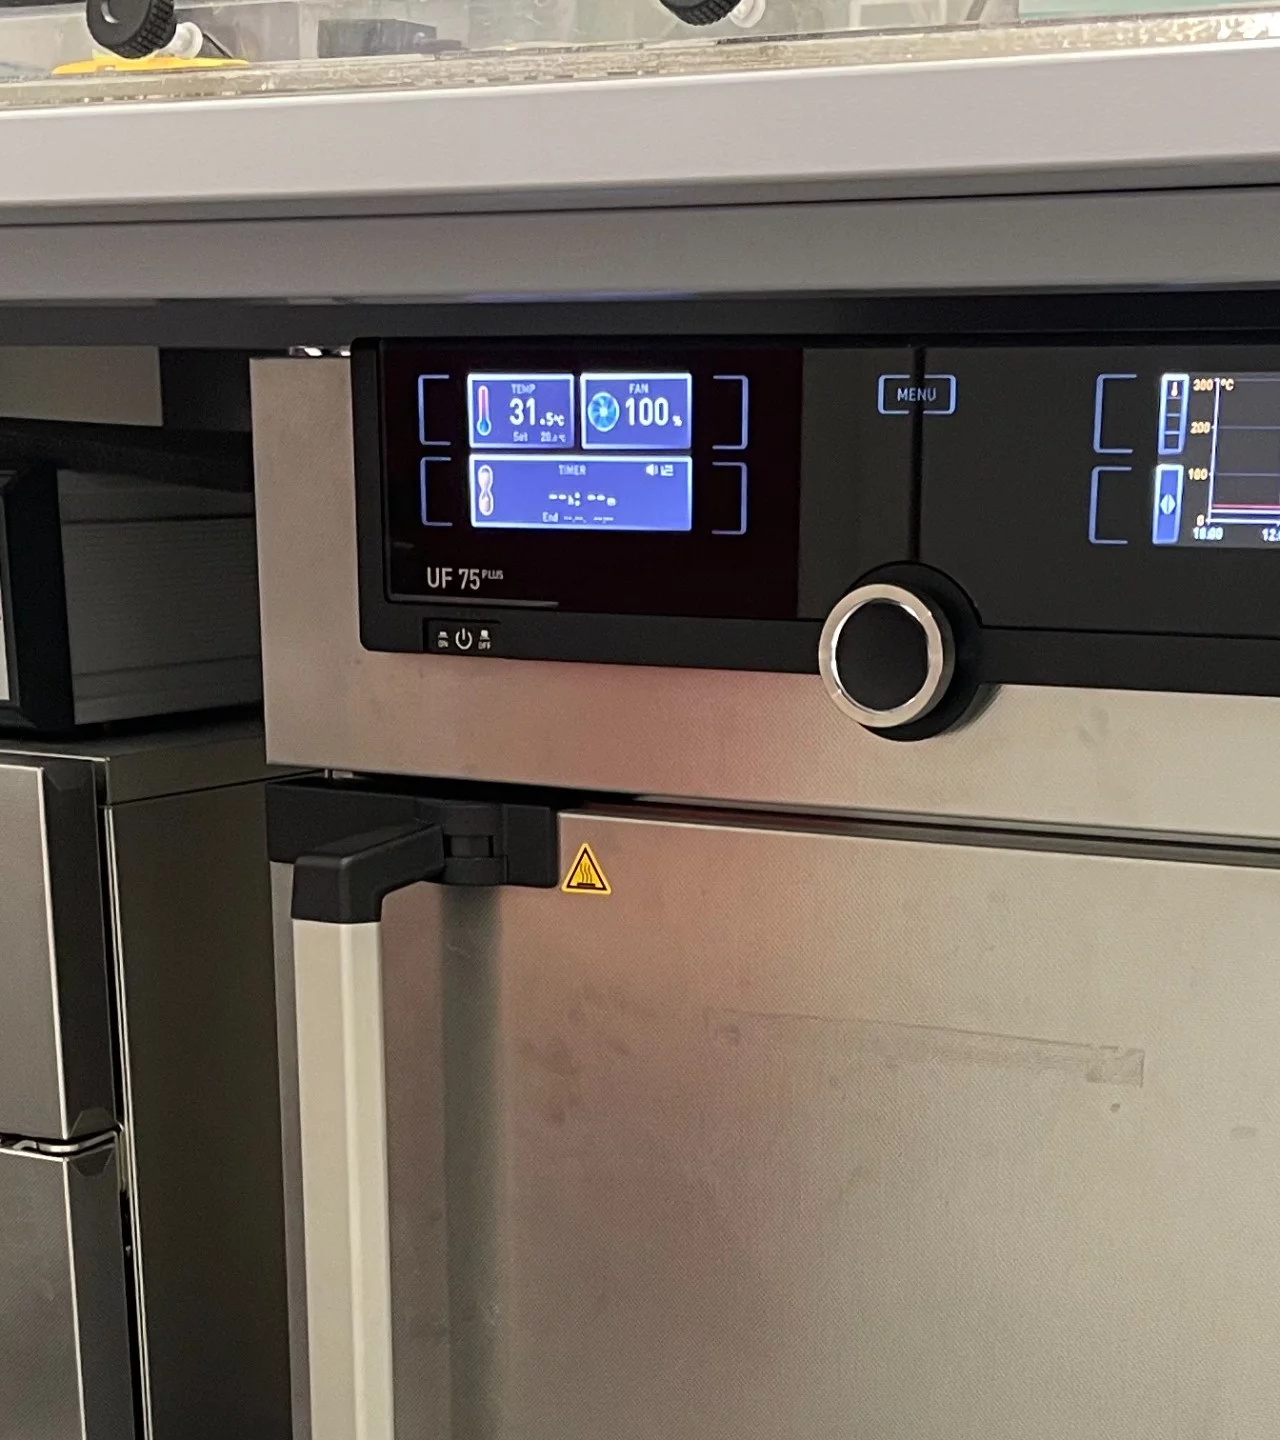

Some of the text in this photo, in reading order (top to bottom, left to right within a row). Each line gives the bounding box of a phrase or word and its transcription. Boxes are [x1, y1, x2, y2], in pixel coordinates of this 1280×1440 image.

[511, 384, 536, 394] TEMP
[629, 384, 649, 394] FAN
[1193, 379, 1213, 391] 300
[897, 387, 937, 402] MENU
[1190, 421, 1211, 434] 200
[558, 464, 586, 476] TIMER
[1188, 468, 1208, 480] 100
[542, 511, 559, 523] End
[426, 566, 453, 589] UF
[478, 641, 491, 650] OFF
